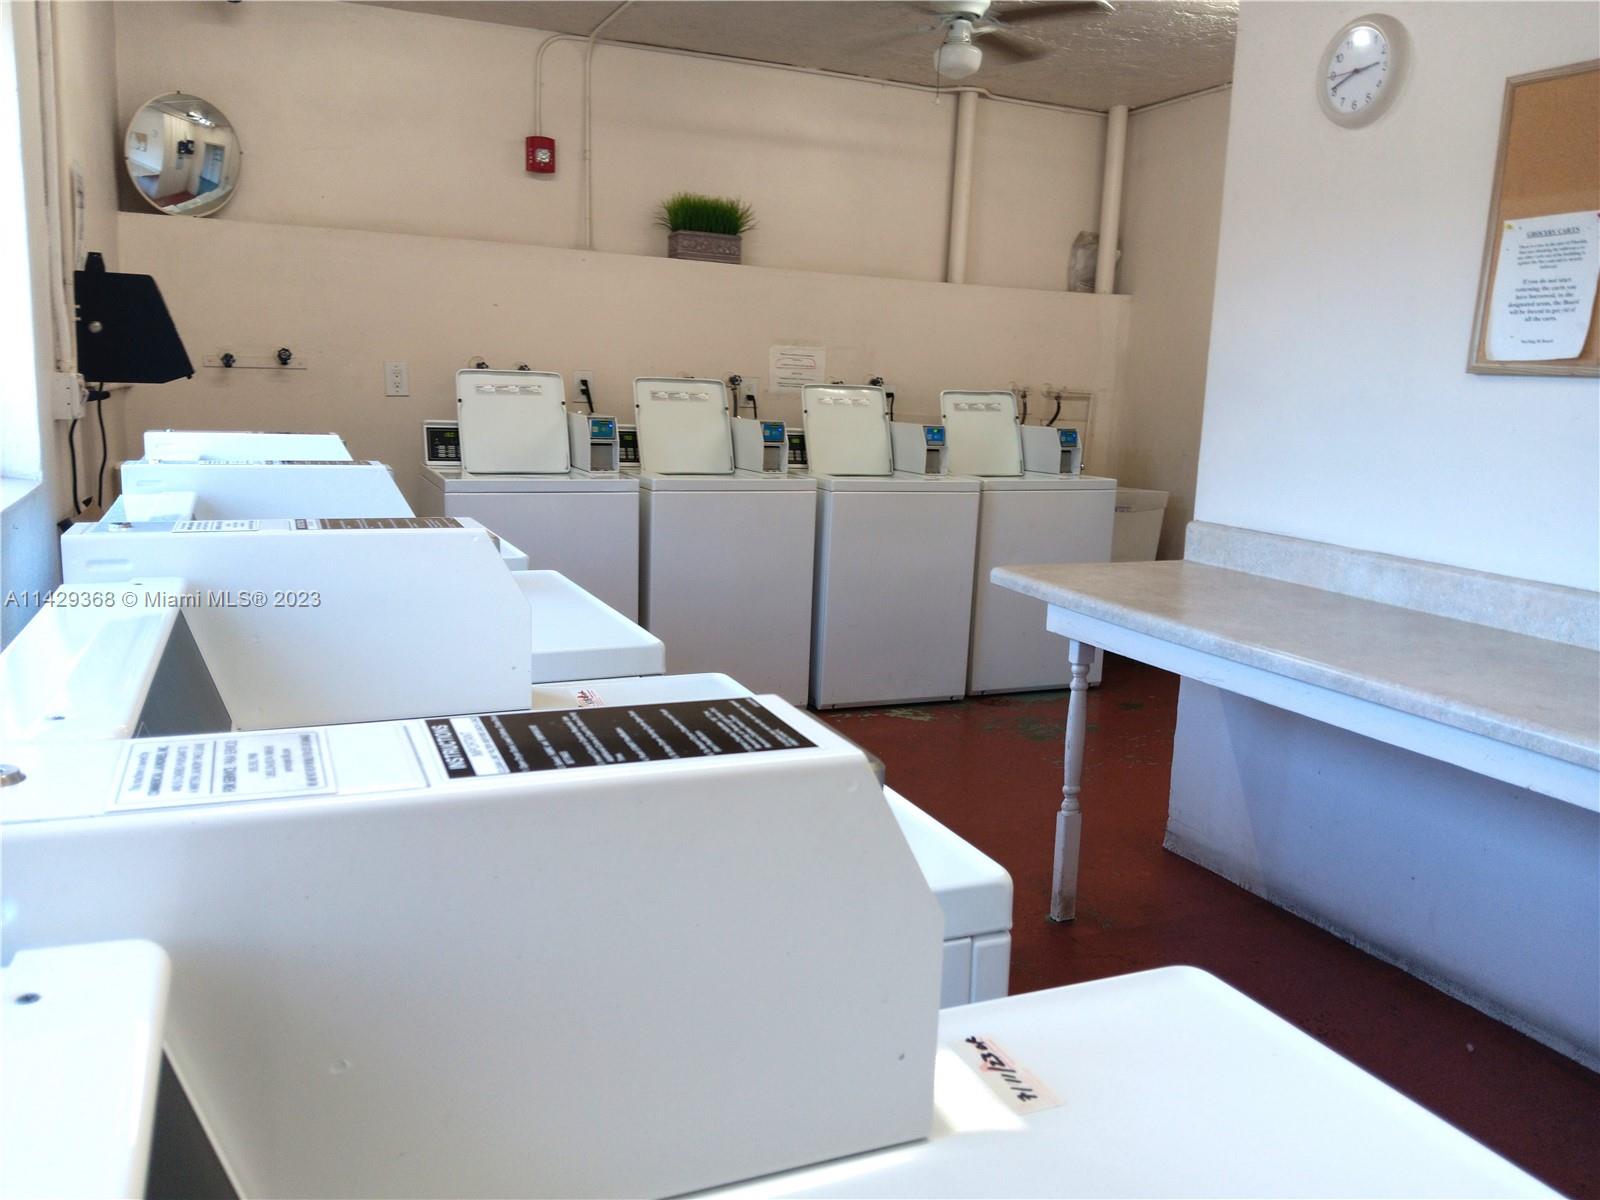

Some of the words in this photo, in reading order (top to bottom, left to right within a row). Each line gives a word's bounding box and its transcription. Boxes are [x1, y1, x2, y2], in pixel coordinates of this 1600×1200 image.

[1336, 53, 1344, 63] 10
[1351, 101, 1358, 110] 6
[431, 725, 468, 769] INSTRUCTIONS
